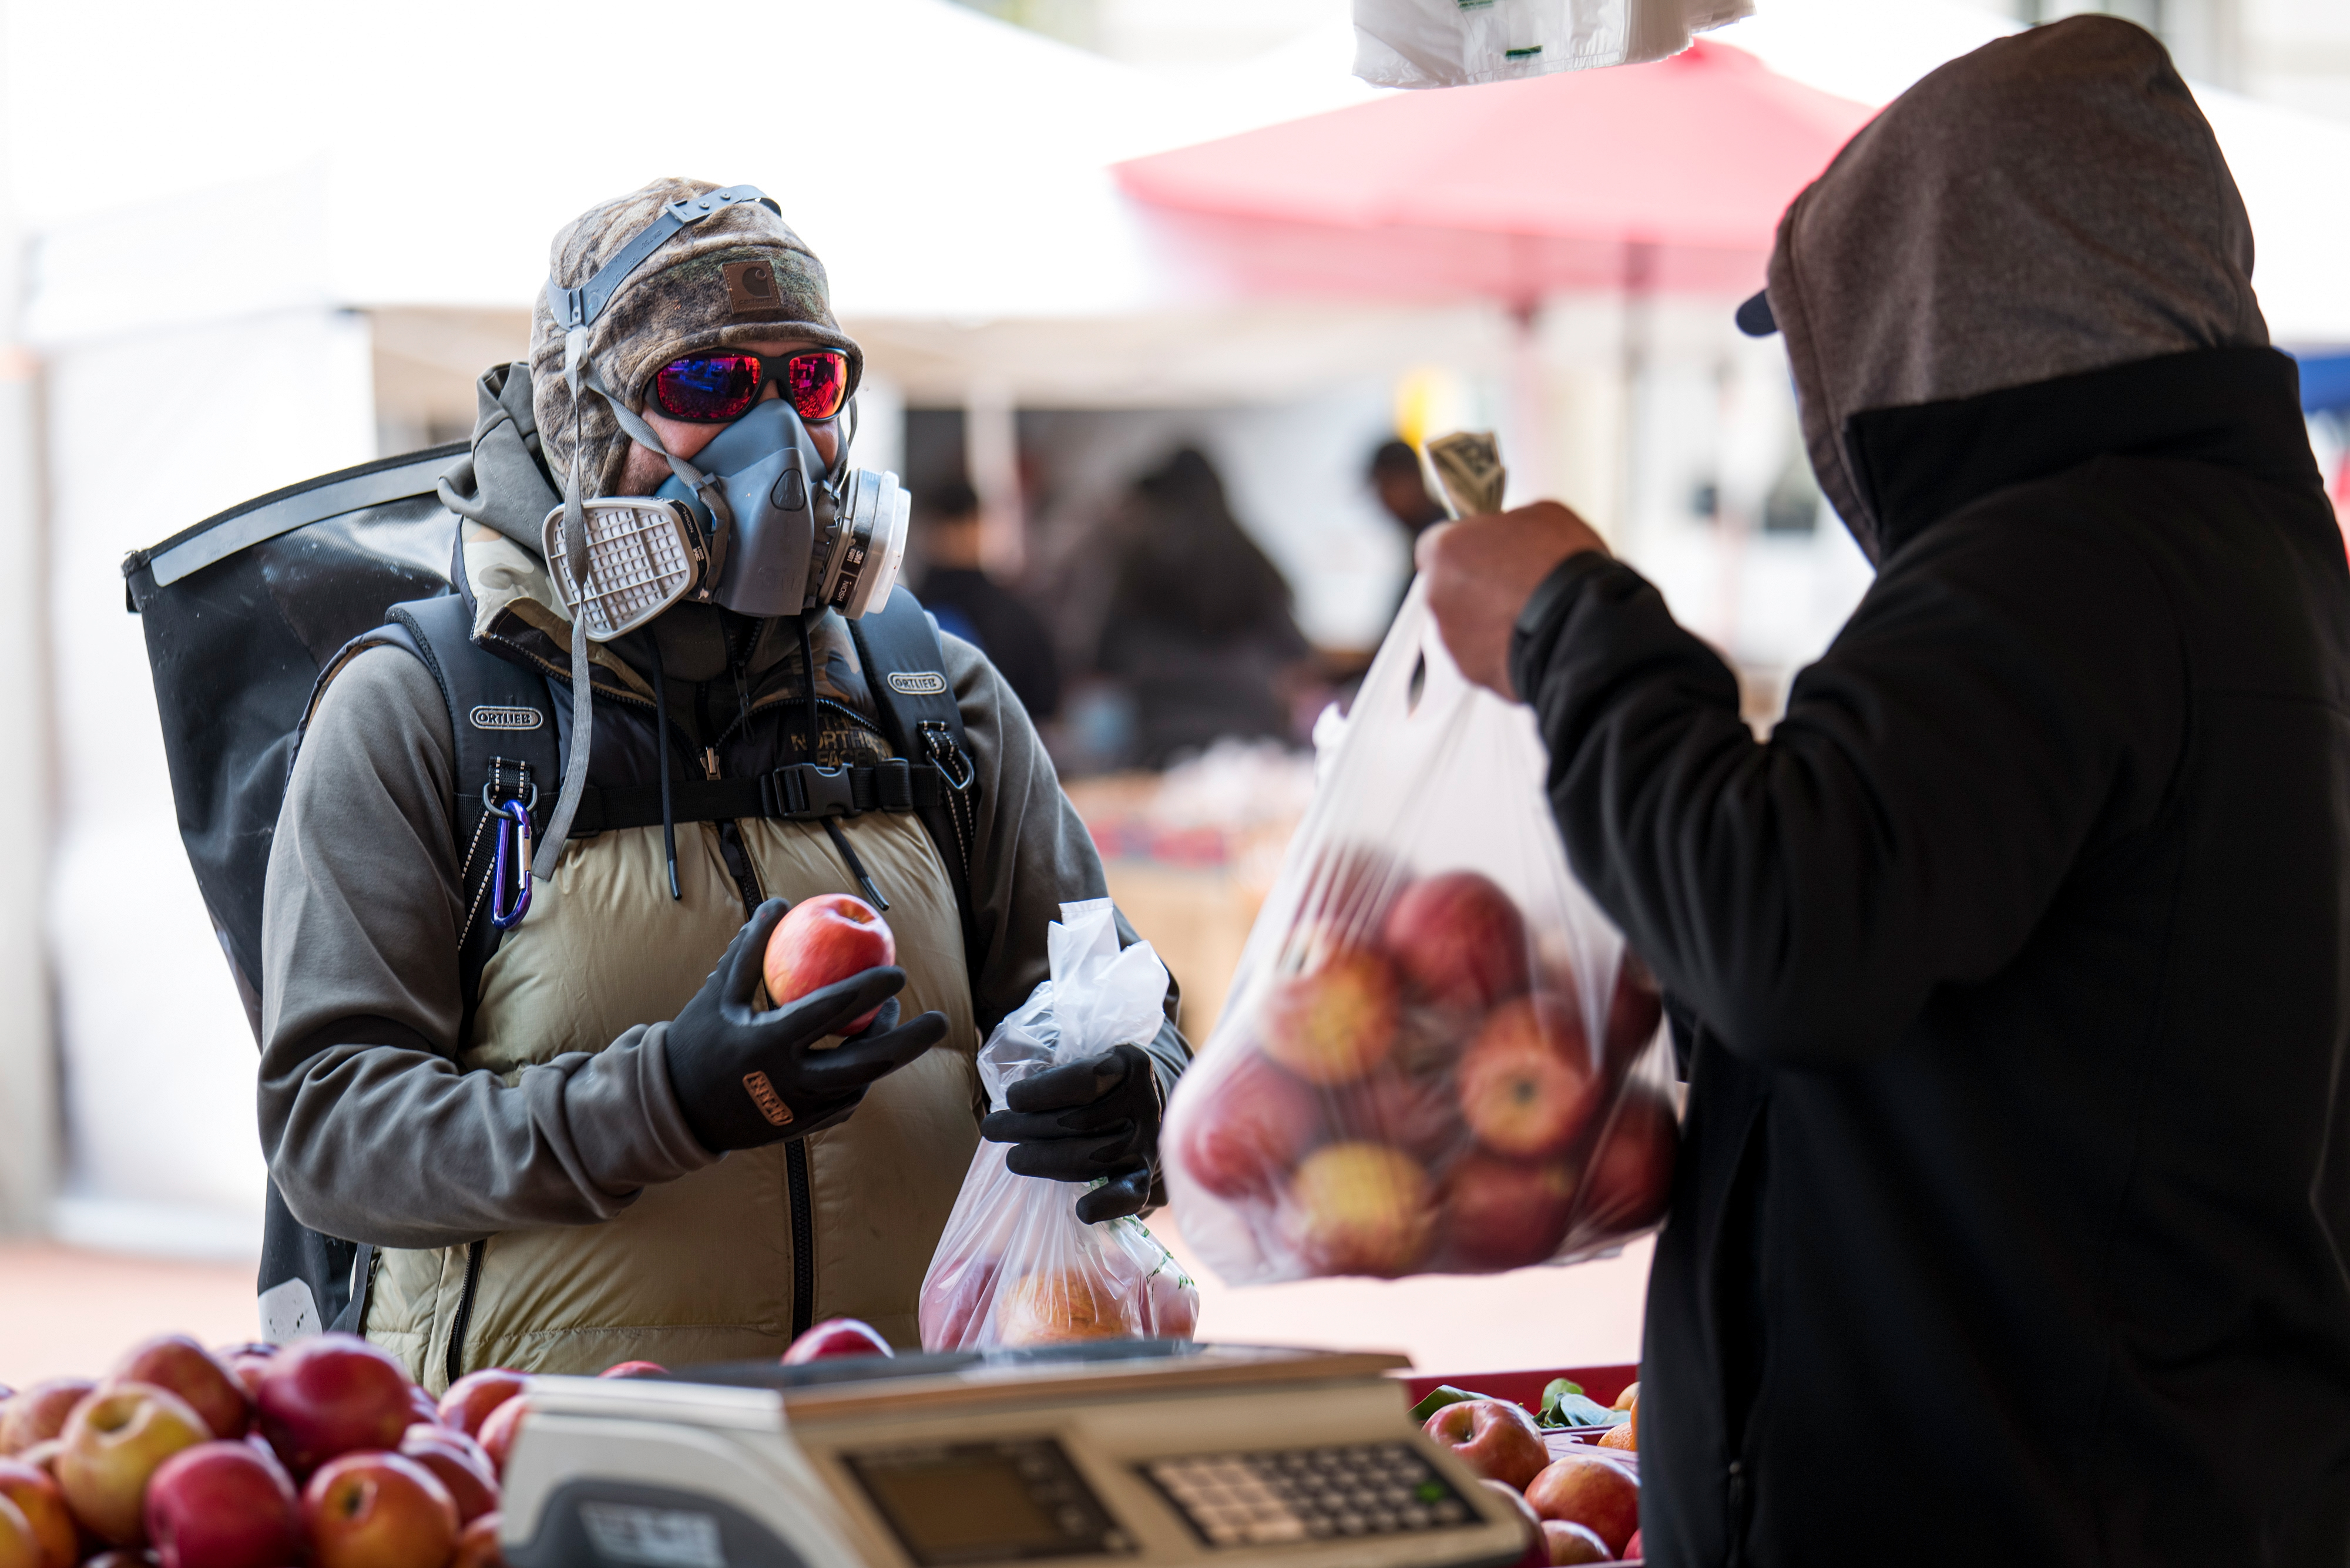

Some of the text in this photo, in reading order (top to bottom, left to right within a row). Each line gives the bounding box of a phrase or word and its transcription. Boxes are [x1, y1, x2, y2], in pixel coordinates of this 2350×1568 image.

[682, 506, 694, 533] NIOSH
[693, 548, 701, 562] 3M
[853, 550, 864, 565] 3M
[837, 580, 849, 602] NIOSH
[895, 678, 936, 689] ORTLIEB
[478, 713, 532, 724] ORTLIEB
